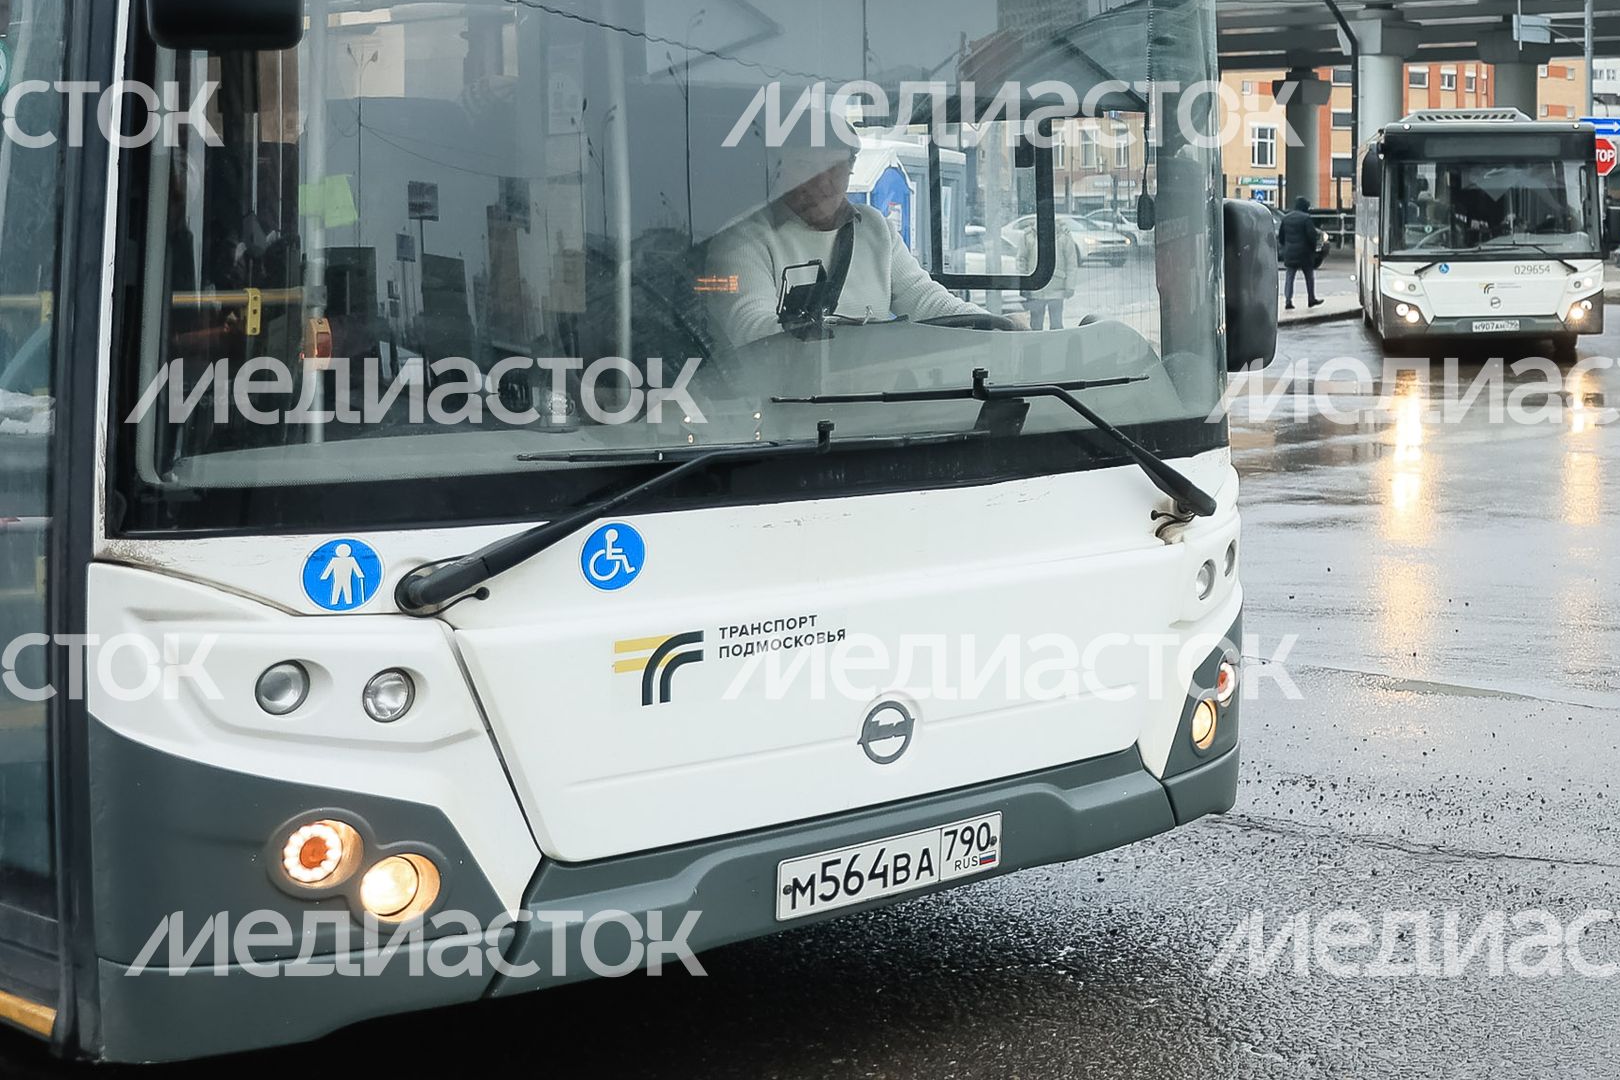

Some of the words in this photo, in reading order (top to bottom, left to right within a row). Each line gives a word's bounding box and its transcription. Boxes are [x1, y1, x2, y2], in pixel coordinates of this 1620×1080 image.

[1596, 149, 1615, 162] TOP
[1514, 264, 1551, 275] 029654
[719, 615, 817, 640] ТРАНСПОРТ
[719, 628, 846, 659] ПОДМОСКОВЬЯ
[791, 847, 935, 910] М564ВА
[944, 822, 992, 861] 790
[954, 857, 978, 872] RUS
